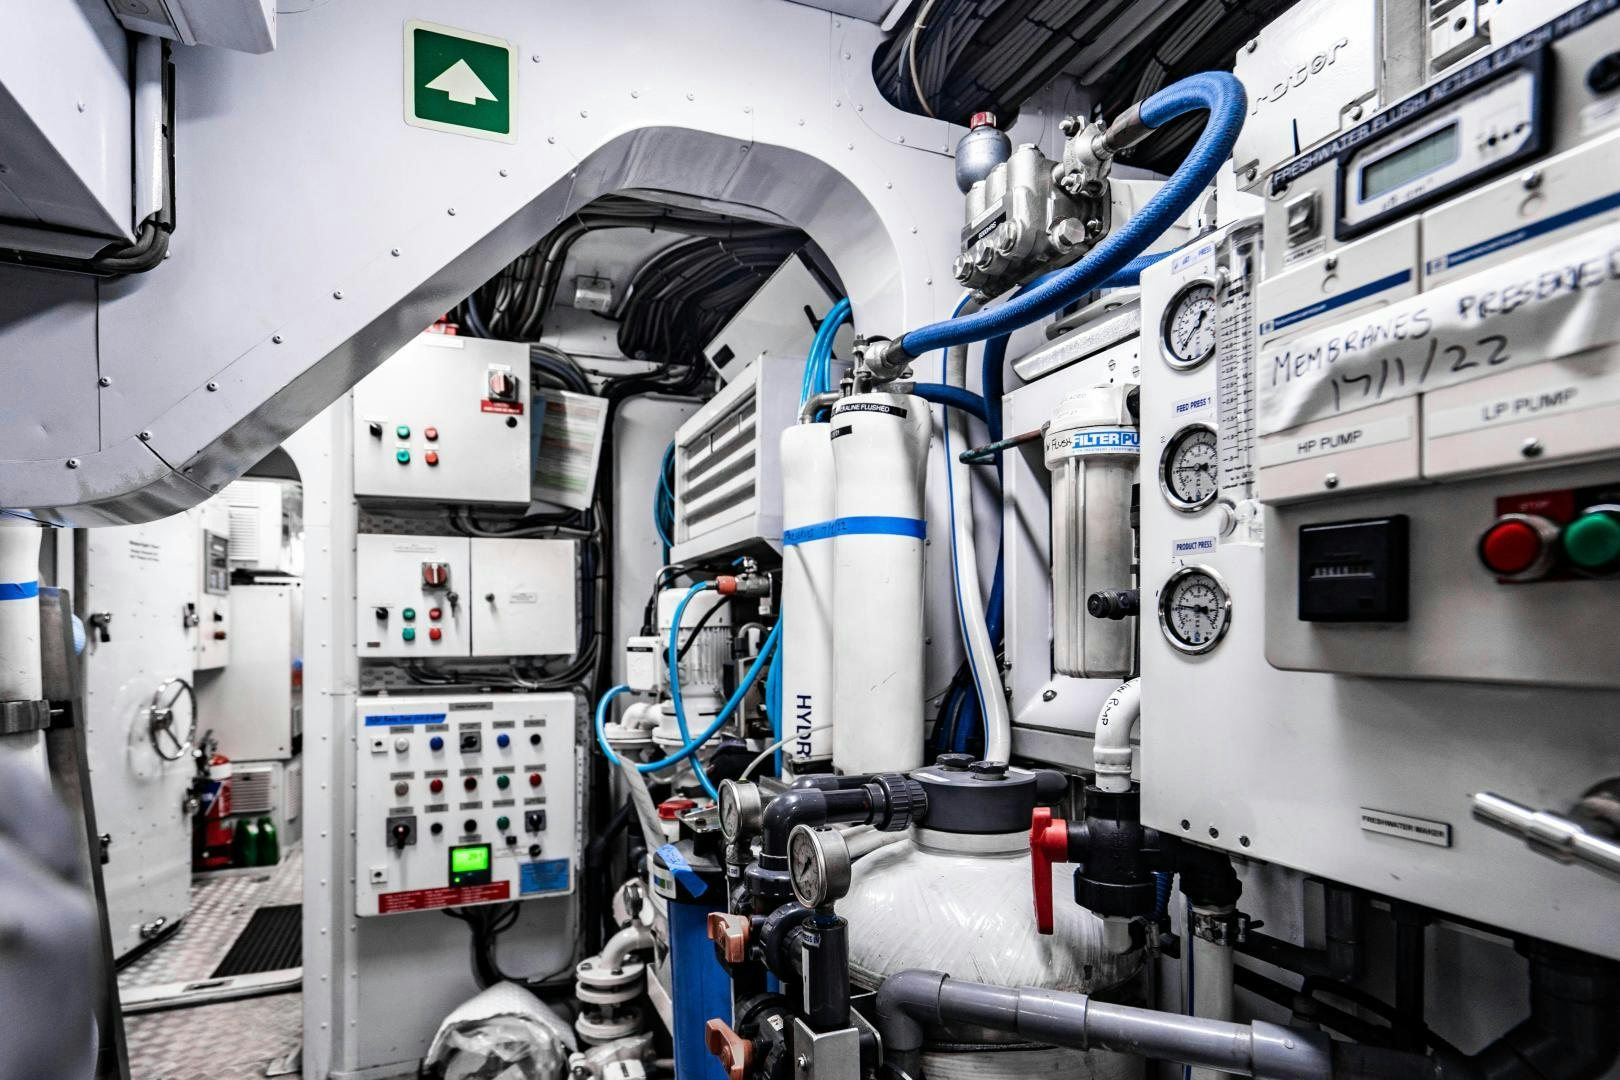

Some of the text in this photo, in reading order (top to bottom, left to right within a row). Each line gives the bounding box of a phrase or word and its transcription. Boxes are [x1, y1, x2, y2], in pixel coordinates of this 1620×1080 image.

[1273, 122, 1371, 186] FRESHWATER
[1372, 92, 1428, 132] FLUSH
[1271, 307, 1434, 387] MEMBRANES
[861, 405, 890, 413] FLUSHED
[1176, 402, 1189, 413] FEED
[1190, 398, 1206, 411] PRESS
[1481, 387, 1578, 421] LP PUMP
[1297, 429, 1363, 454] HP PUMP
[1176, 539, 1213, 552] PRODUCT PRESS
[1362, 815, 1413, 832] FRESHWATER
